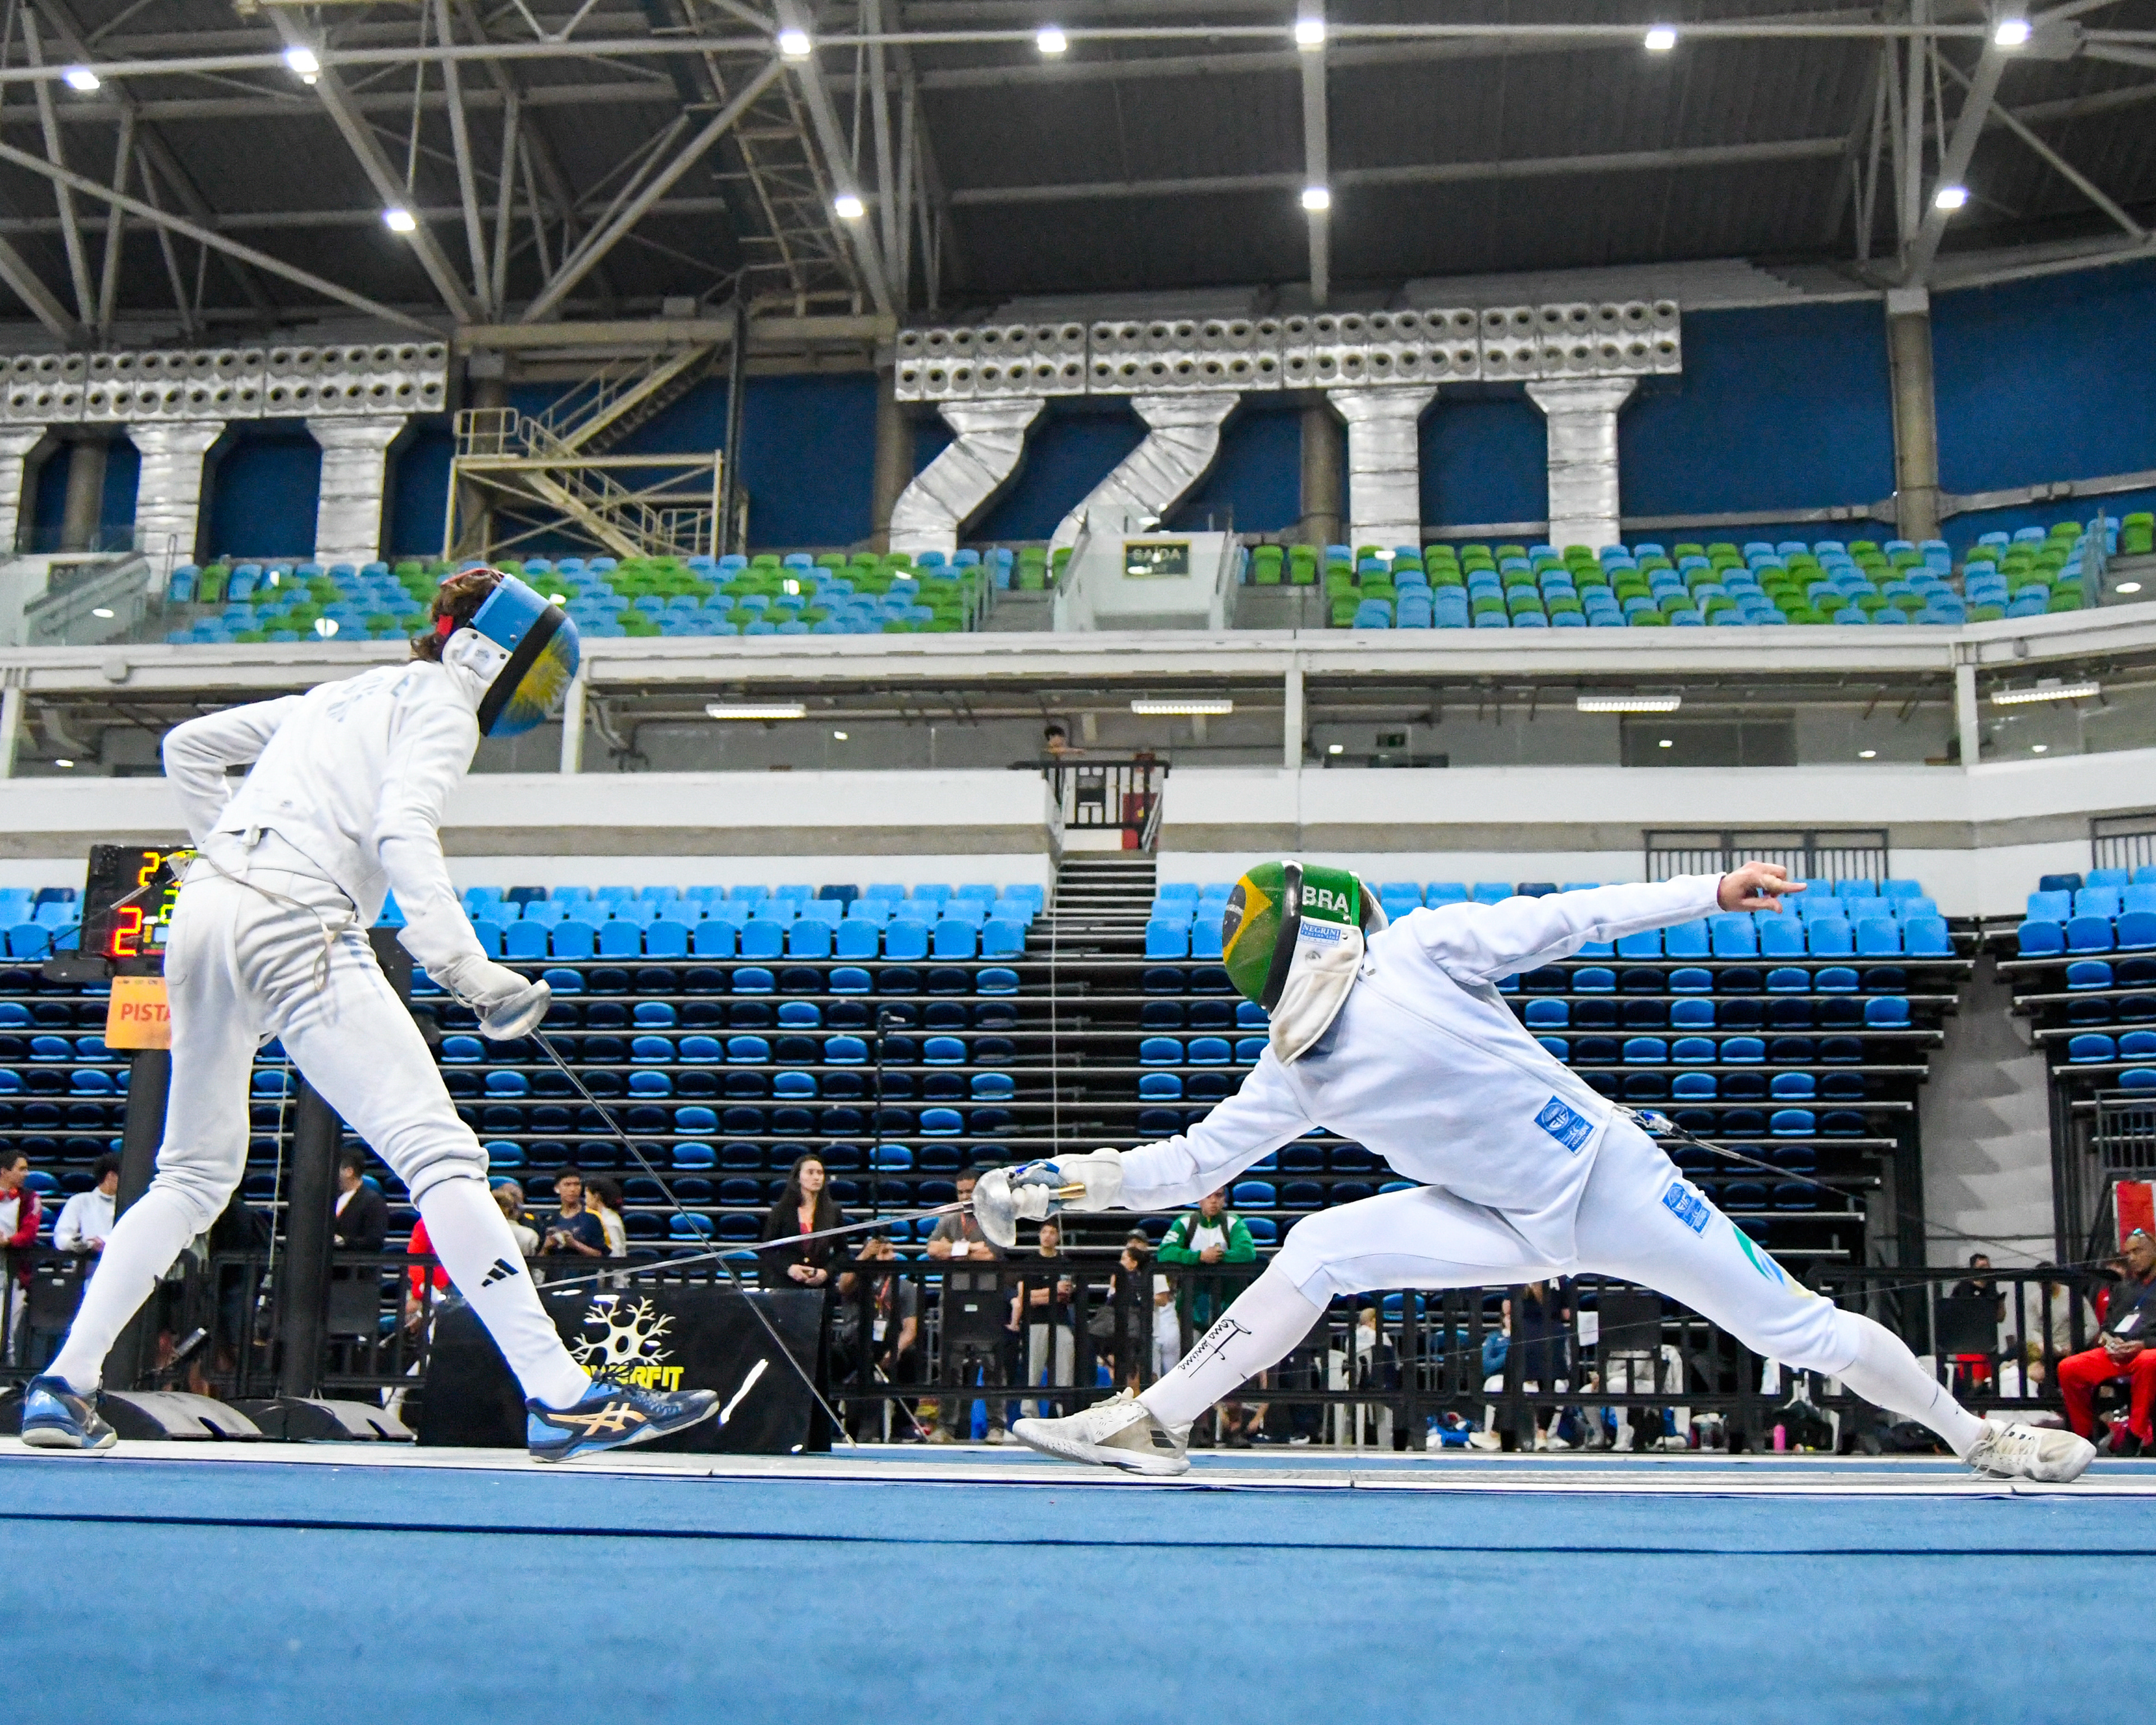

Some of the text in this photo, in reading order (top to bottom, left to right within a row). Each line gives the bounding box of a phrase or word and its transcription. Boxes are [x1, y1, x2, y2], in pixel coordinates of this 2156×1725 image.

[1302, 885, 1349, 913] BRA
[113, 906, 143, 956] 2
[1302, 924, 1340, 937] NEGRINI
